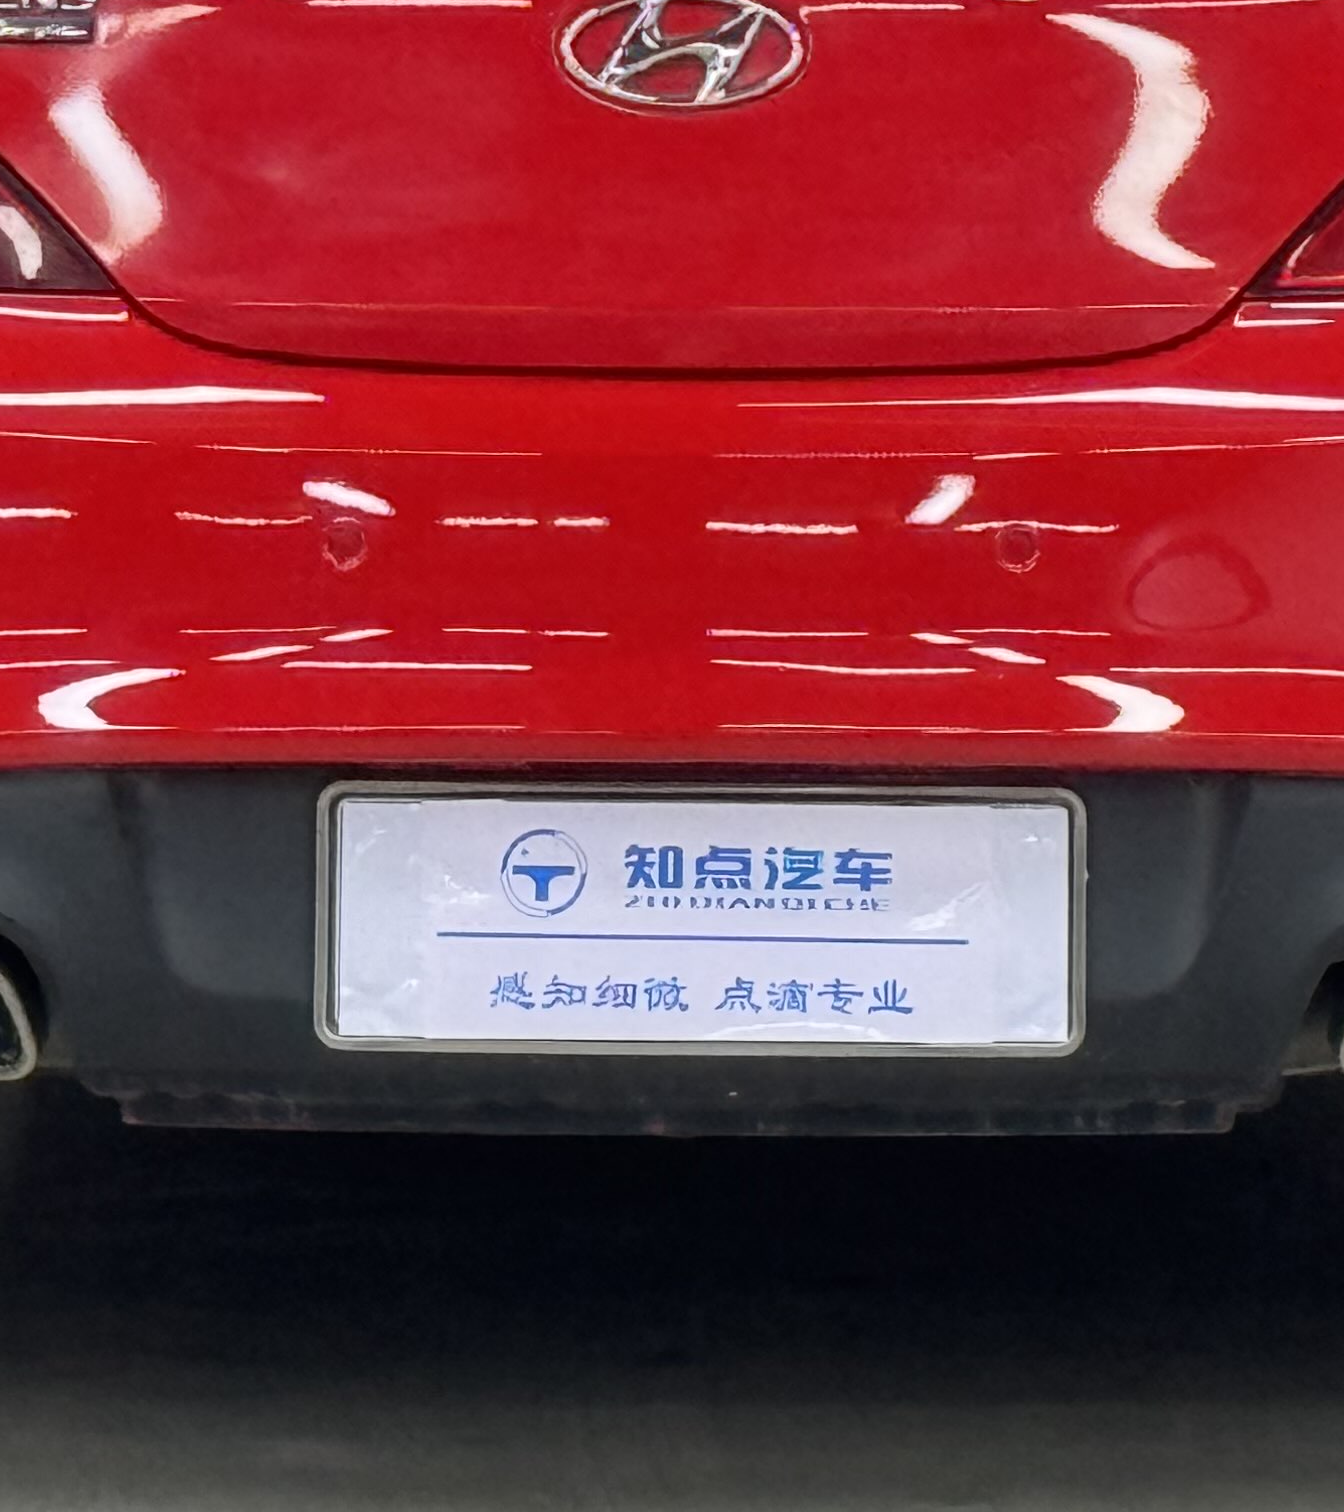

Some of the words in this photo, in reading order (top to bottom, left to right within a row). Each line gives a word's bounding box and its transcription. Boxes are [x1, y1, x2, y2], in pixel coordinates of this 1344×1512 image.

[624, 844, 893, 891] 知点汽车
[714, 976, 914, 1015] 点滴专业
